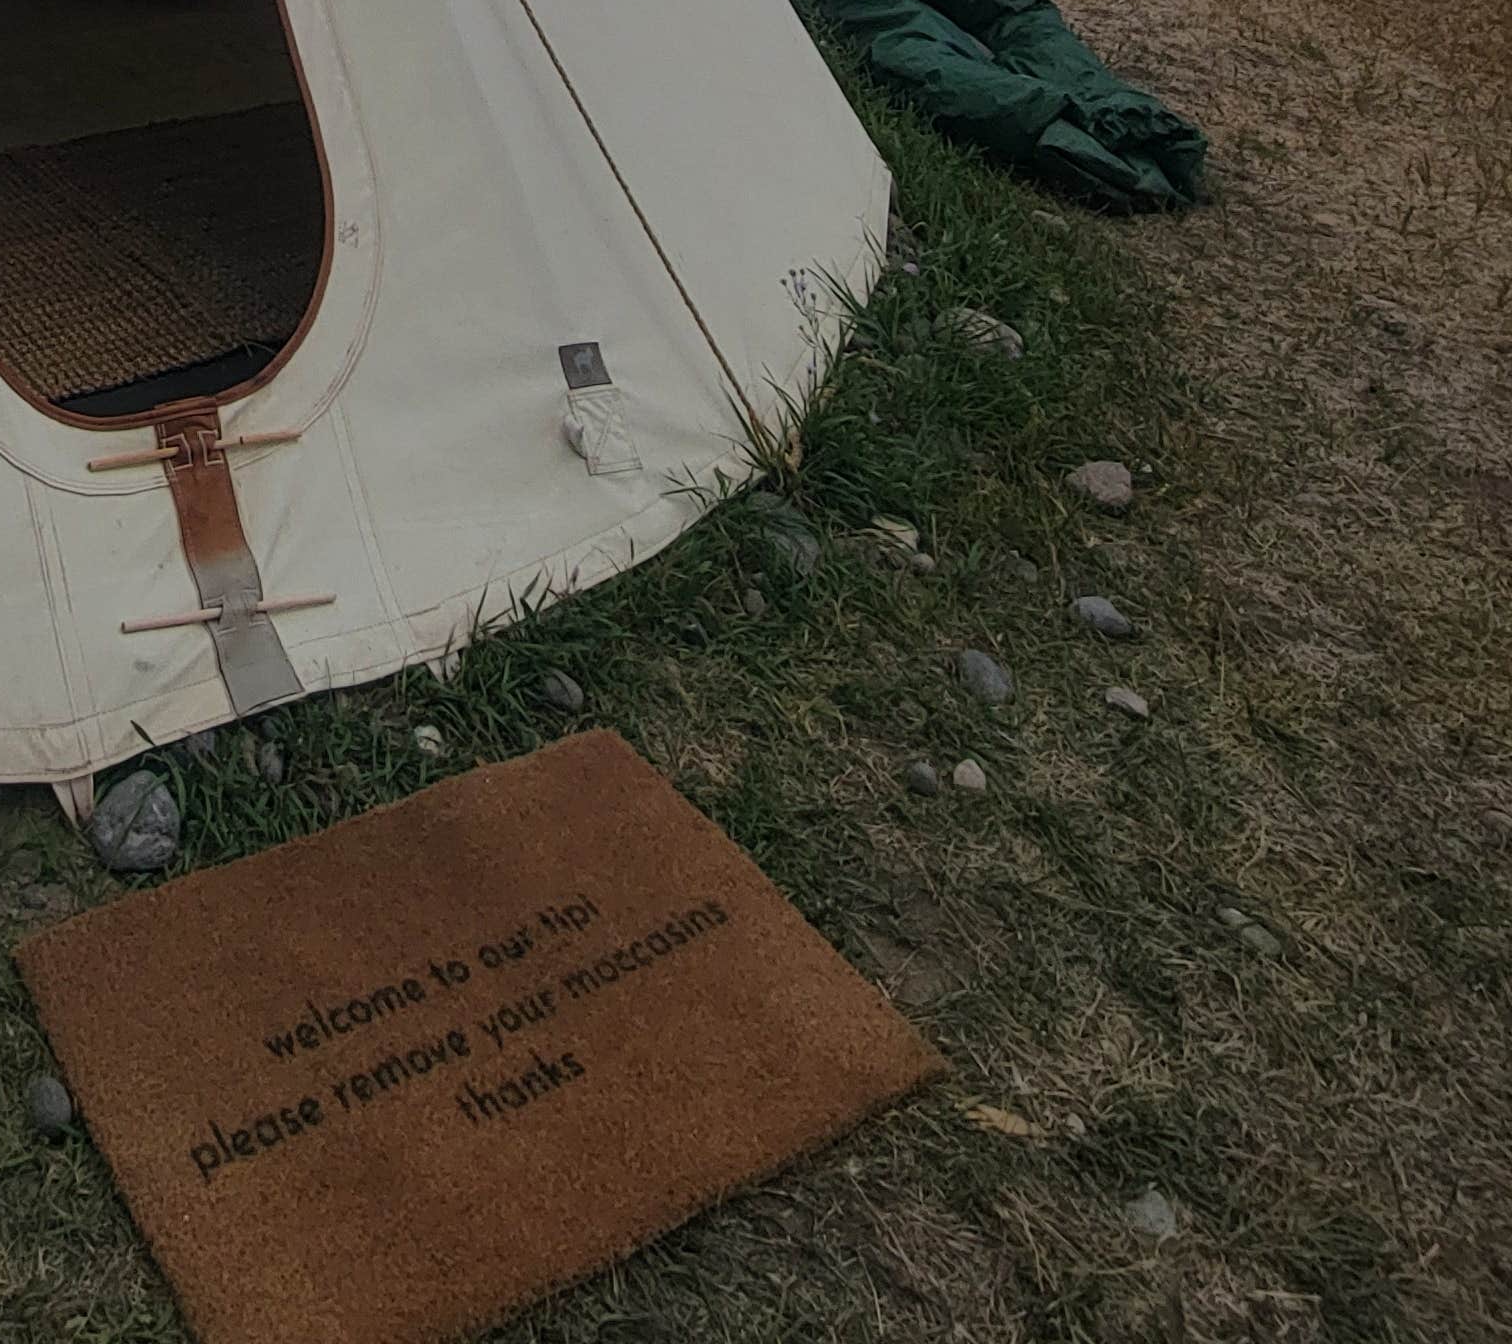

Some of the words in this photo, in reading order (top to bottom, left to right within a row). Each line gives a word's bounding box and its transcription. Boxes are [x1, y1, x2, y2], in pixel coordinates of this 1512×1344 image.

[190, 1094, 325, 1179] please
[332, 1027, 471, 1113] remove
[480, 990, 558, 1050] your
[563, 899, 731, 1000] moccasins
[262, 978, 427, 1061] welcome
[430, 959, 471, 993] to
[479, 928, 535, 970] our
[541, 893, 601, 938] tipi
[456, 1048, 587, 1125] thanks
